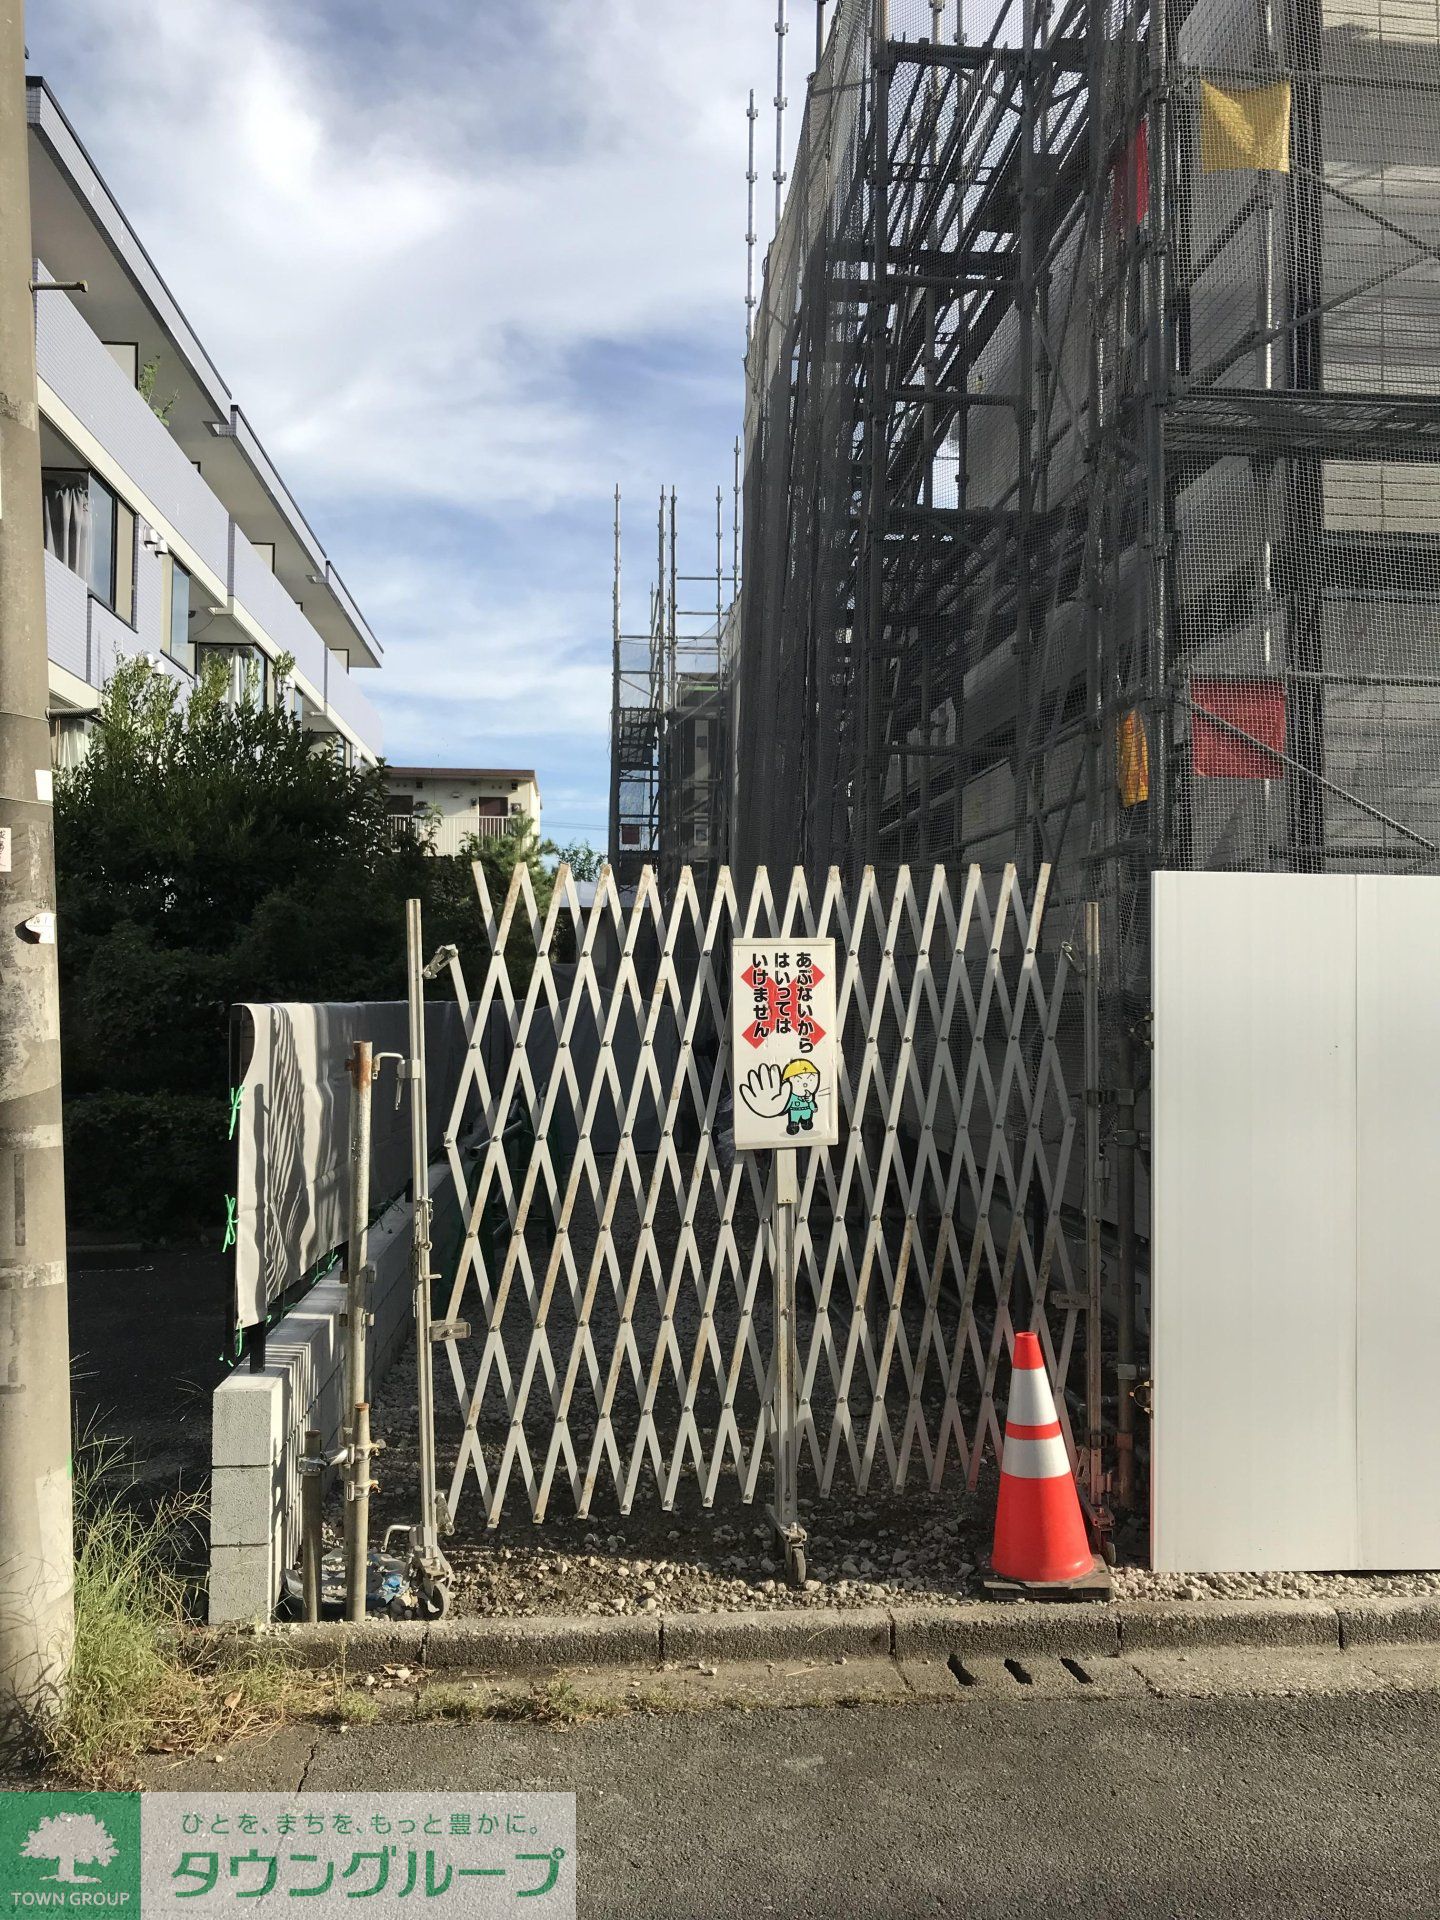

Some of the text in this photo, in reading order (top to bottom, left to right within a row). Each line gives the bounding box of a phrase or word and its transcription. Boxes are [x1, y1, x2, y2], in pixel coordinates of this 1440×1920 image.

[752, 953, 770, 1038] いけません
[774, 952, 792, 1034] はいっては
[796, 952, 814, 1054] あぶないから
